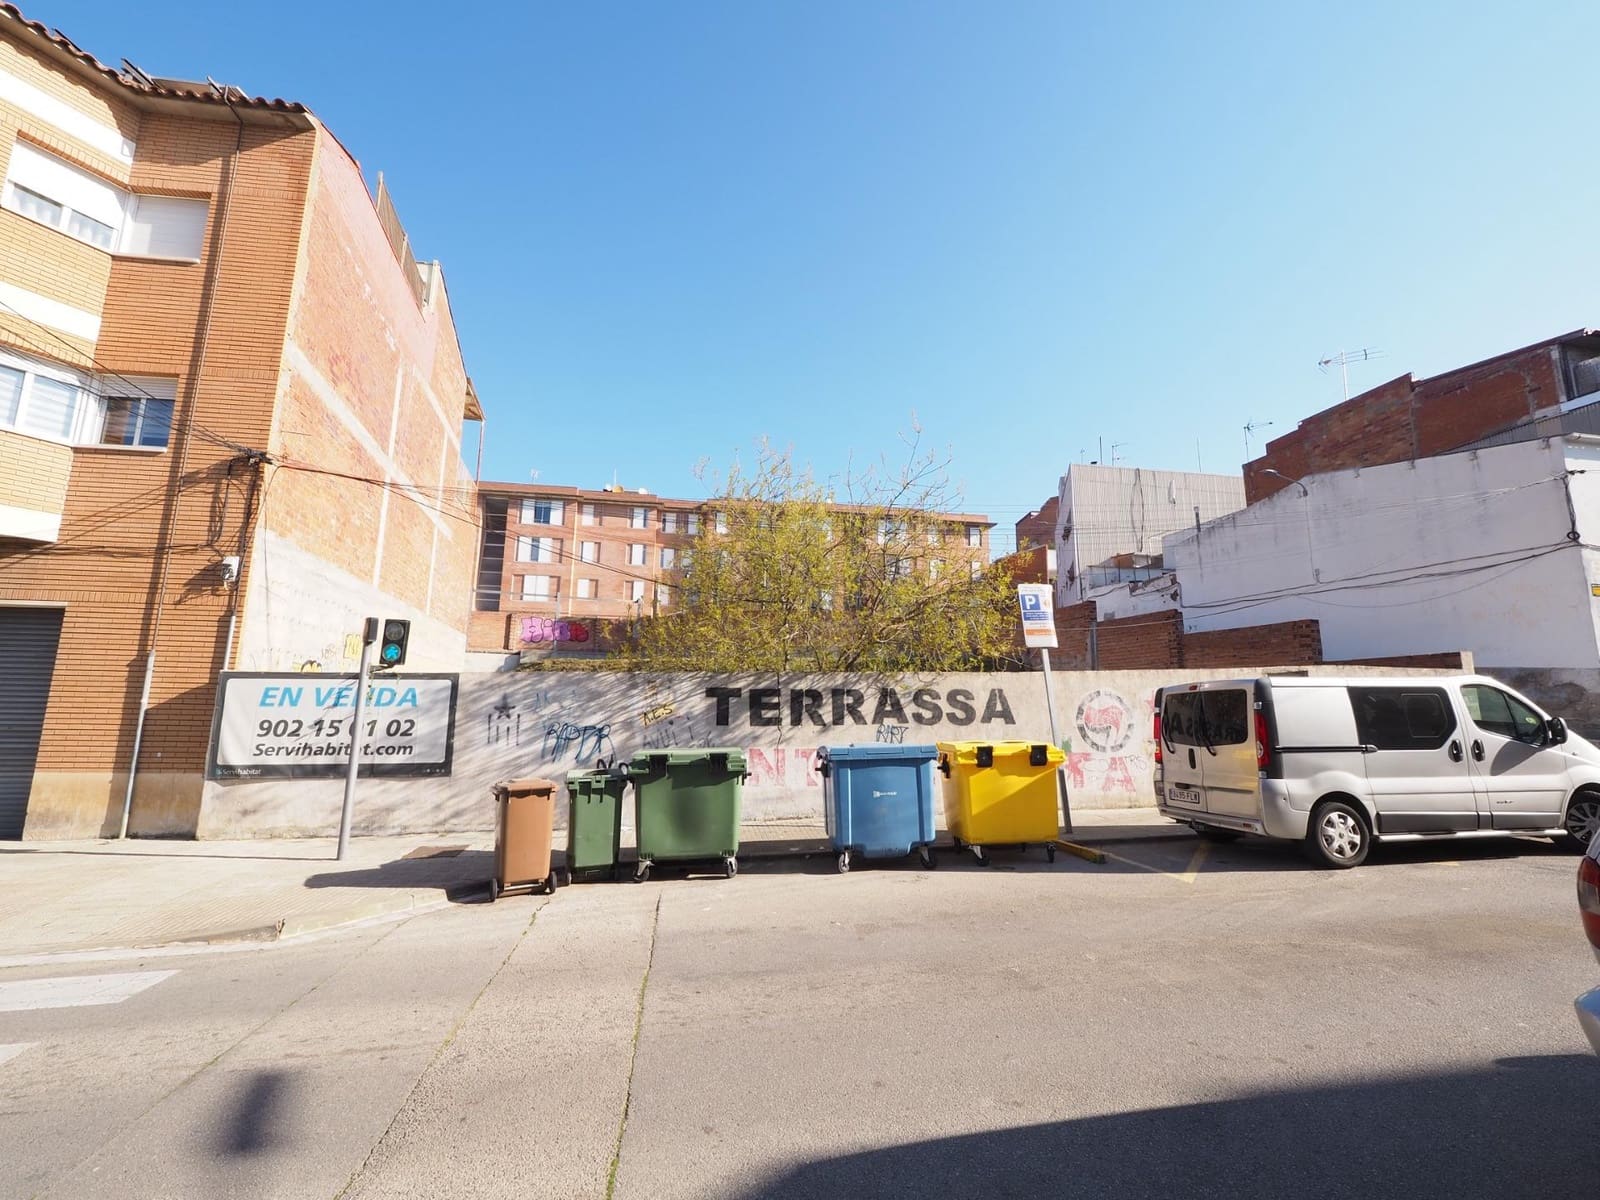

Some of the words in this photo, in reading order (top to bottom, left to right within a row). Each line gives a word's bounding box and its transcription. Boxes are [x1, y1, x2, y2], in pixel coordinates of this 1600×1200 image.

[1024, 595, 1036, 609] P
[258, 686, 304, 708] EN
[705, 687, 1017, 727] TERRASSA
[256, 719, 304, 738] 902
[312, 719, 343, 738] 15
[385, 719, 417, 738] 02
[252, 742, 414, 758] Servihabitt.com
